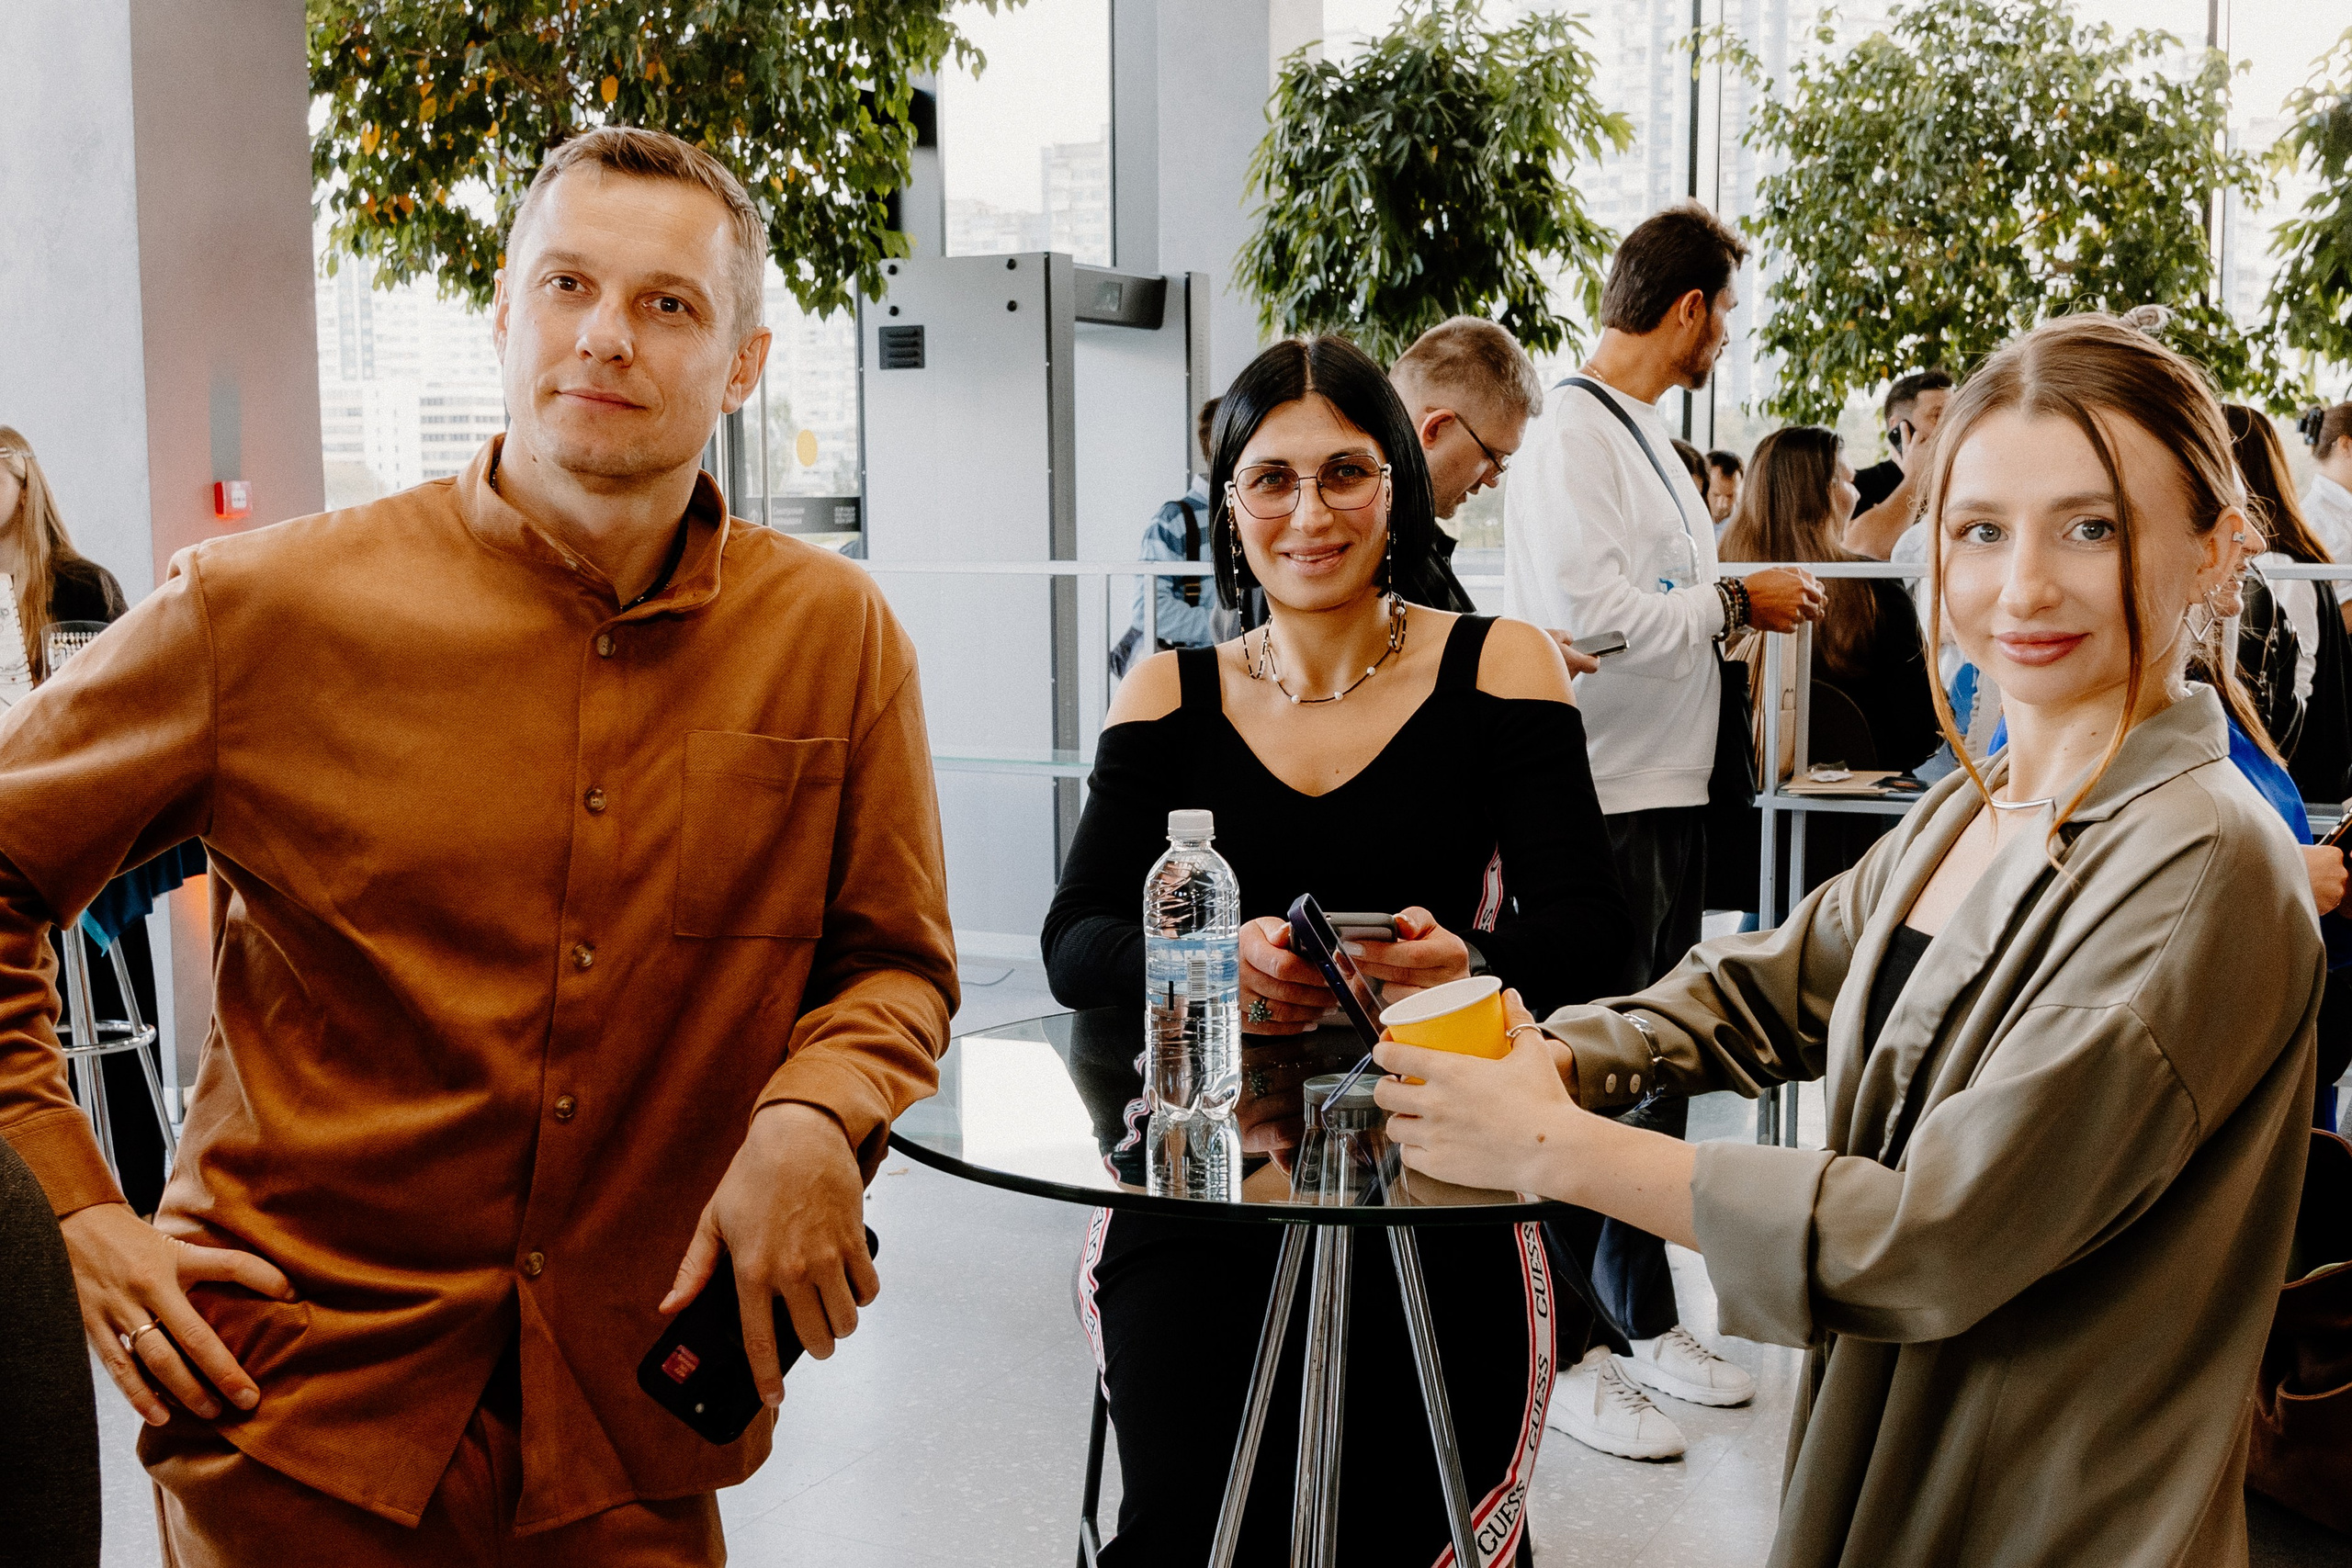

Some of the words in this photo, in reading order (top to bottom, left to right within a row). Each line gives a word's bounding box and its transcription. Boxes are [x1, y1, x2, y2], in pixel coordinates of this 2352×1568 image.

[1524, 1224, 1547, 1318] GUESS
[1529, 1353, 1548, 1451] GUESS
[1477, 1480, 1524, 1555] GUESS
